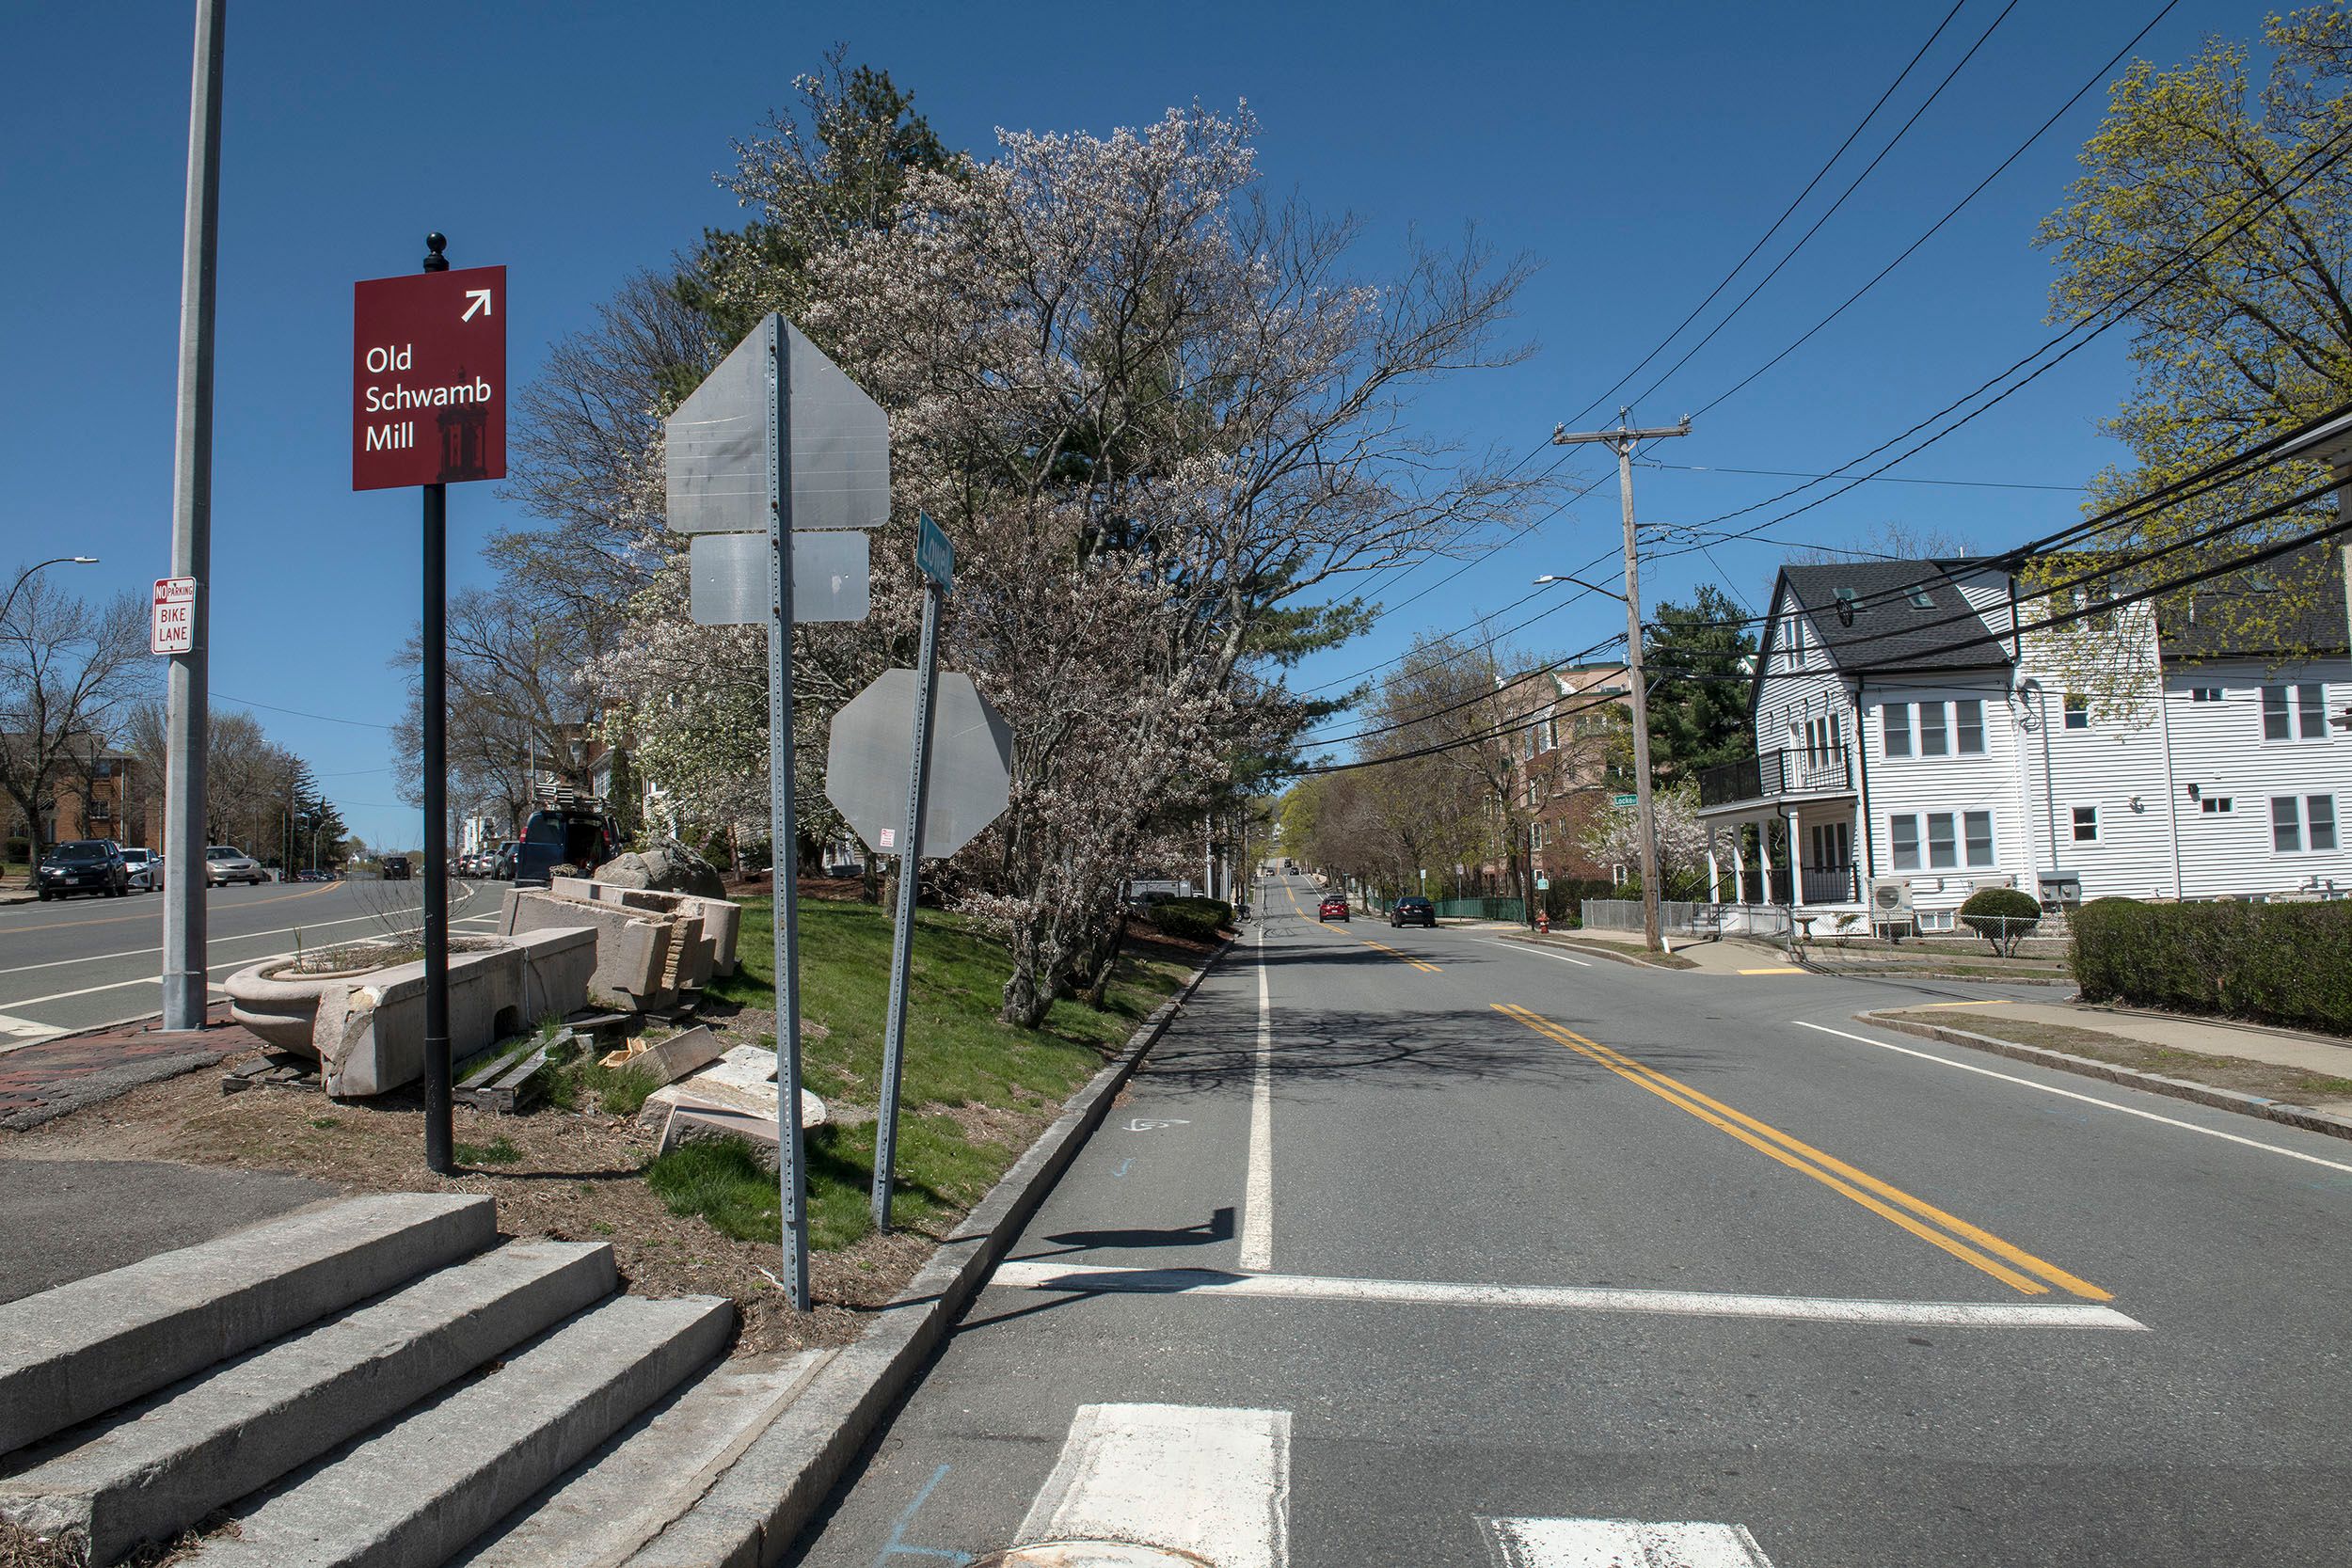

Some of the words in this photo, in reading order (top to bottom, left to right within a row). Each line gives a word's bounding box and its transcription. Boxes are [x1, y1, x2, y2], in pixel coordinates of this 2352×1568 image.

[366, 343, 412, 373] Old
[365, 375, 491, 413] Schwamb
[365, 421, 414, 451] Mill
[155, 585, 167, 599] NO
[167, 585, 193, 596] PARKING
[161, 608, 186, 623] BIKE
[159, 626, 187, 641] LANE
